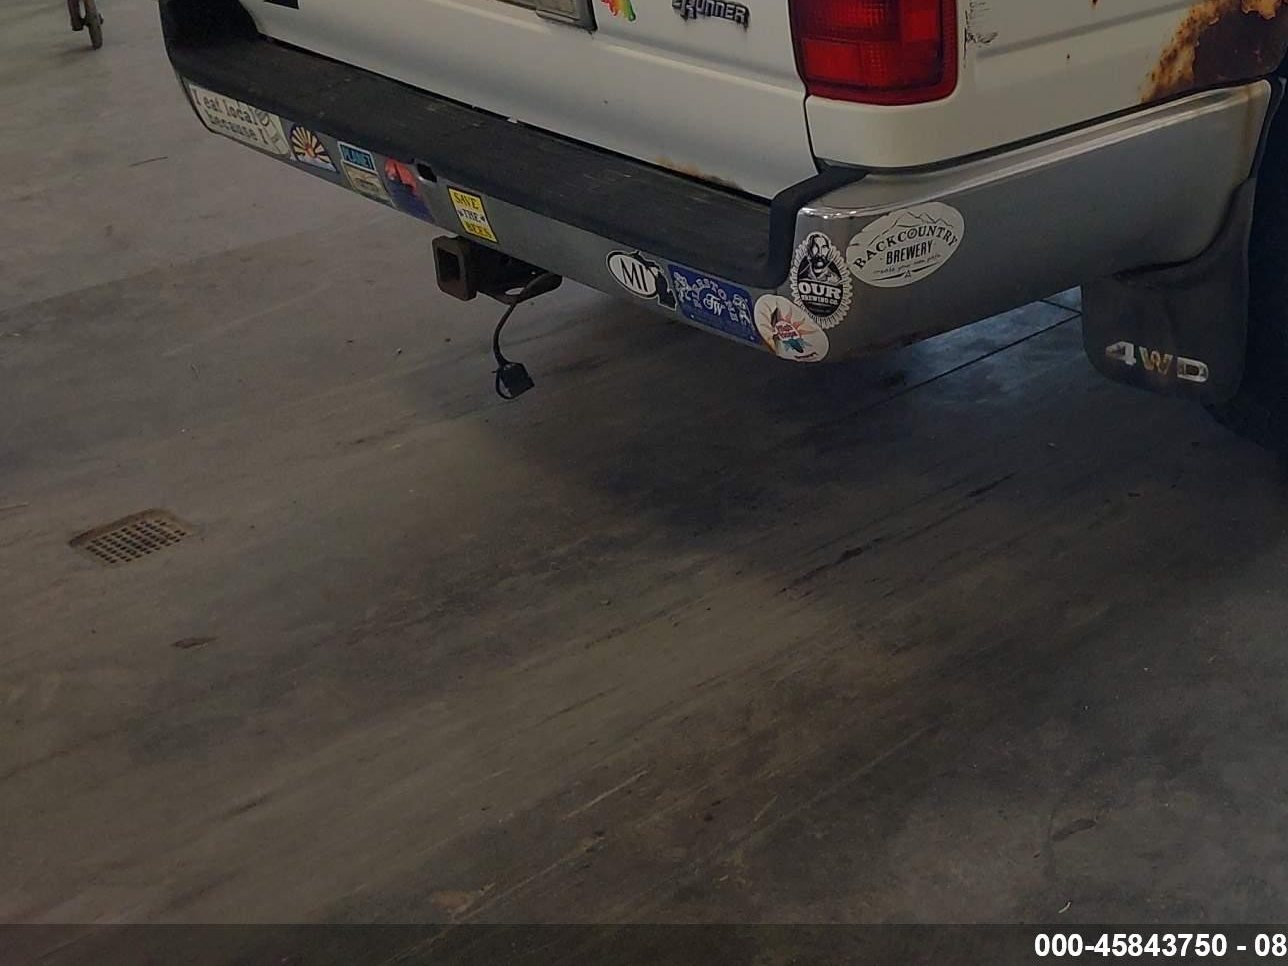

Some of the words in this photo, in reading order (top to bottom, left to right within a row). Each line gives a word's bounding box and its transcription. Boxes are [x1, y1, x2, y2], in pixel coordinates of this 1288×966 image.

[203, 96, 222, 113] eat
[222, 99, 259, 125] local
[453, 192, 480, 210] SAVE
[462, 208, 483, 223] THE
[852, 225, 959, 270] BACKCOUNTRY
[886, 240, 933, 265] BREWERY
[620, 257, 649, 293] MI
[798, 281, 842, 300] OUR
[801, 294, 828, 304] BREWING
[1105, 341, 1209, 383] 4WD
